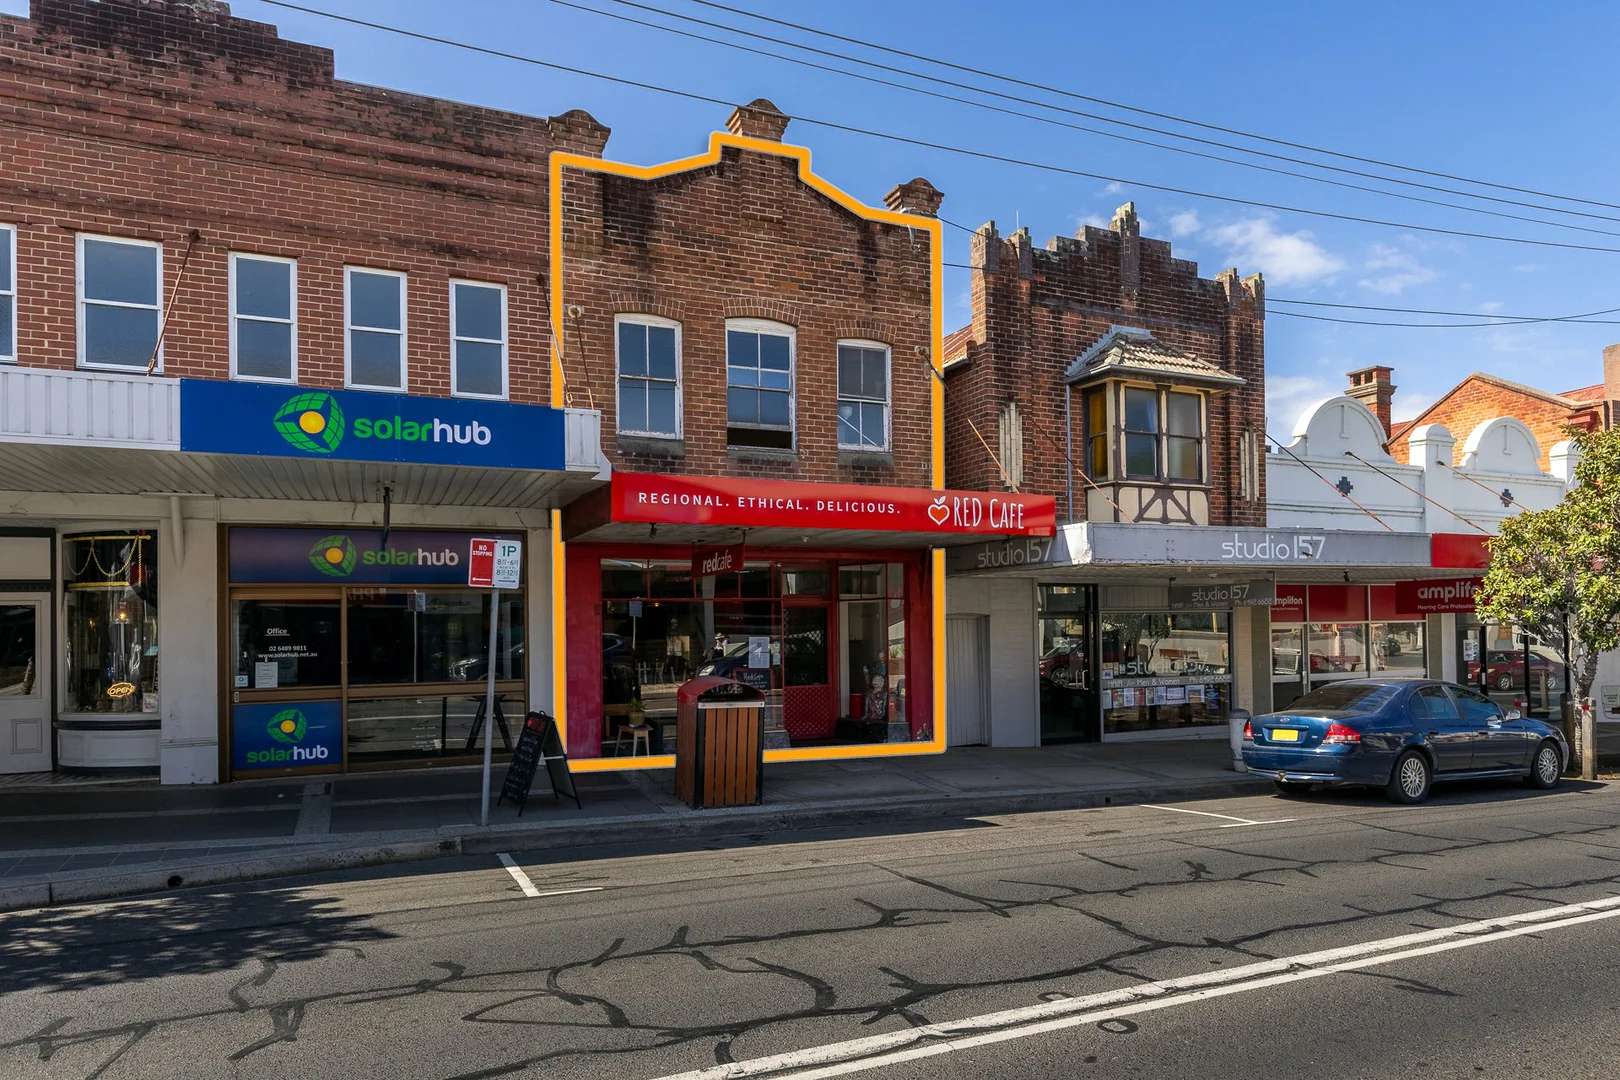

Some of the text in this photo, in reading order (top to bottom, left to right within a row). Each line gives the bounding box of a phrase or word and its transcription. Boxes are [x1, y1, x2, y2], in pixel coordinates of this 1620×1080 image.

[353, 415, 492, 445] solarhub
[638, 492, 901, 514] REGIONAL. ETHICAL. DELICIOUS.
[953, 496, 1025, 529] RED CAFE
[501, 545, 517, 557] 1P
[977, 537, 1053, 568] studio 157
[1221, 533, 1326, 559] studio 157
[362, 548, 459, 566] solarhub
[702, 549, 732, 573] redcafe
[1191, 584, 1250, 601] studio 157
[258, 651, 318, 659] www.solarhub.net.au
[1127, 654, 1180, 675] studio
[1107, 679, 1123, 688] HAIR
[1151, 678, 1157, 686] &
[247, 744, 329, 763] solarhub
